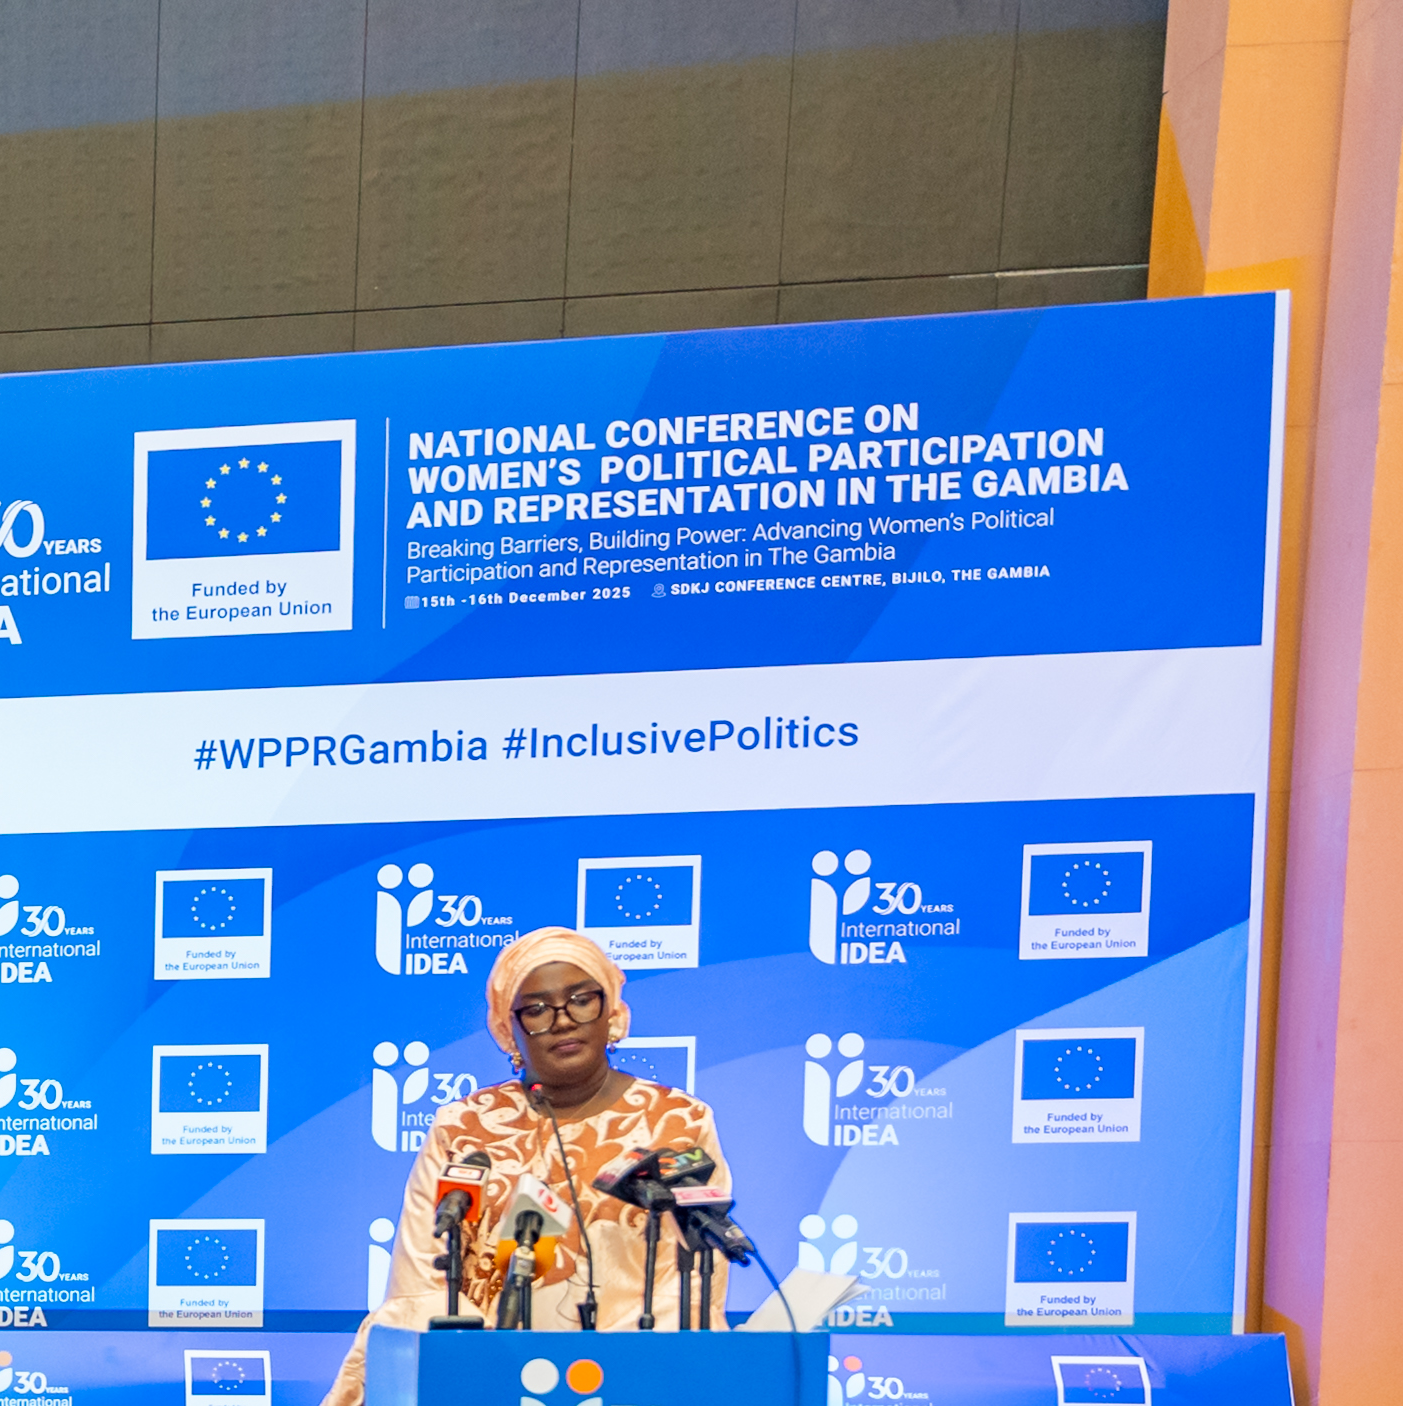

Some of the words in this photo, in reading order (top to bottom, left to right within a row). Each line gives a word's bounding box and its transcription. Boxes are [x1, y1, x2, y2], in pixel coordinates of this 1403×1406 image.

[409, 423, 596, 460] NATIONAL
[606, 406, 854, 448] CONFERENCE
[864, 402, 919, 433] ON
[601, 446, 798, 484] POLITICAL
[808, 427, 1104, 472] PARTICIPATION
[406, 498, 483, 529] AND
[494, 479, 825, 524] REPRESENTATION
[837, 476, 876, 506] IN
[885, 471, 962, 503] THE
[972, 463, 1129, 498] GAMBIA
[43, 538, 102, 557] YEARS
[408, 539, 494, 560] Breaking
[501, 534, 583, 554] Barriers,
[590, 529, 670, 551] Building
[677, 527, 746, 545] Power:
[752, 519, 862, 541] Advancing
[972, 507, 1054, 530] Political
[407, 561, 533, 585] Participation
[539, 557, 577, 578] and
[583, 551, 738, 578] Representation
[745, 549, 762, 567] in
[768, 546, 808, 566] The
[814, 542, 895, 564] Gambia
[192, 581, 259, 597] Funded
[266, 580, 287, 597] by
[671, 582, 709, 595] SDKJ
[715, 576, 816, 593] CONFERENCE
[821, 573, 886, 588] CENTRE,
[892, 570, 945, 584] BIJILO,
[951, 568, 981, 581] THE
[987, 565, 1050, 580] GAMBIA
[152, 607, 179, 622] the
[187, 606, 272, 622] European
[279, 601, 331, 616] Union
[422, 595, 455, 607] 15th
[461, 593, 503, 605] -16th
[509, 590, 586, 604] December
[592, 586, 630, 599] 2025
[194, 730, 487, 770] #WPPRGambia
[502, 716, 858, 759] #InclusivePolitics
[1031, 942, 1048, 950] the
[1051, 941, 1102, 951] European
[1105, 940, 1136, 948] Union
[1055, 928, 1095, 937] Funded
[1098, 928, 1111, 937] by
